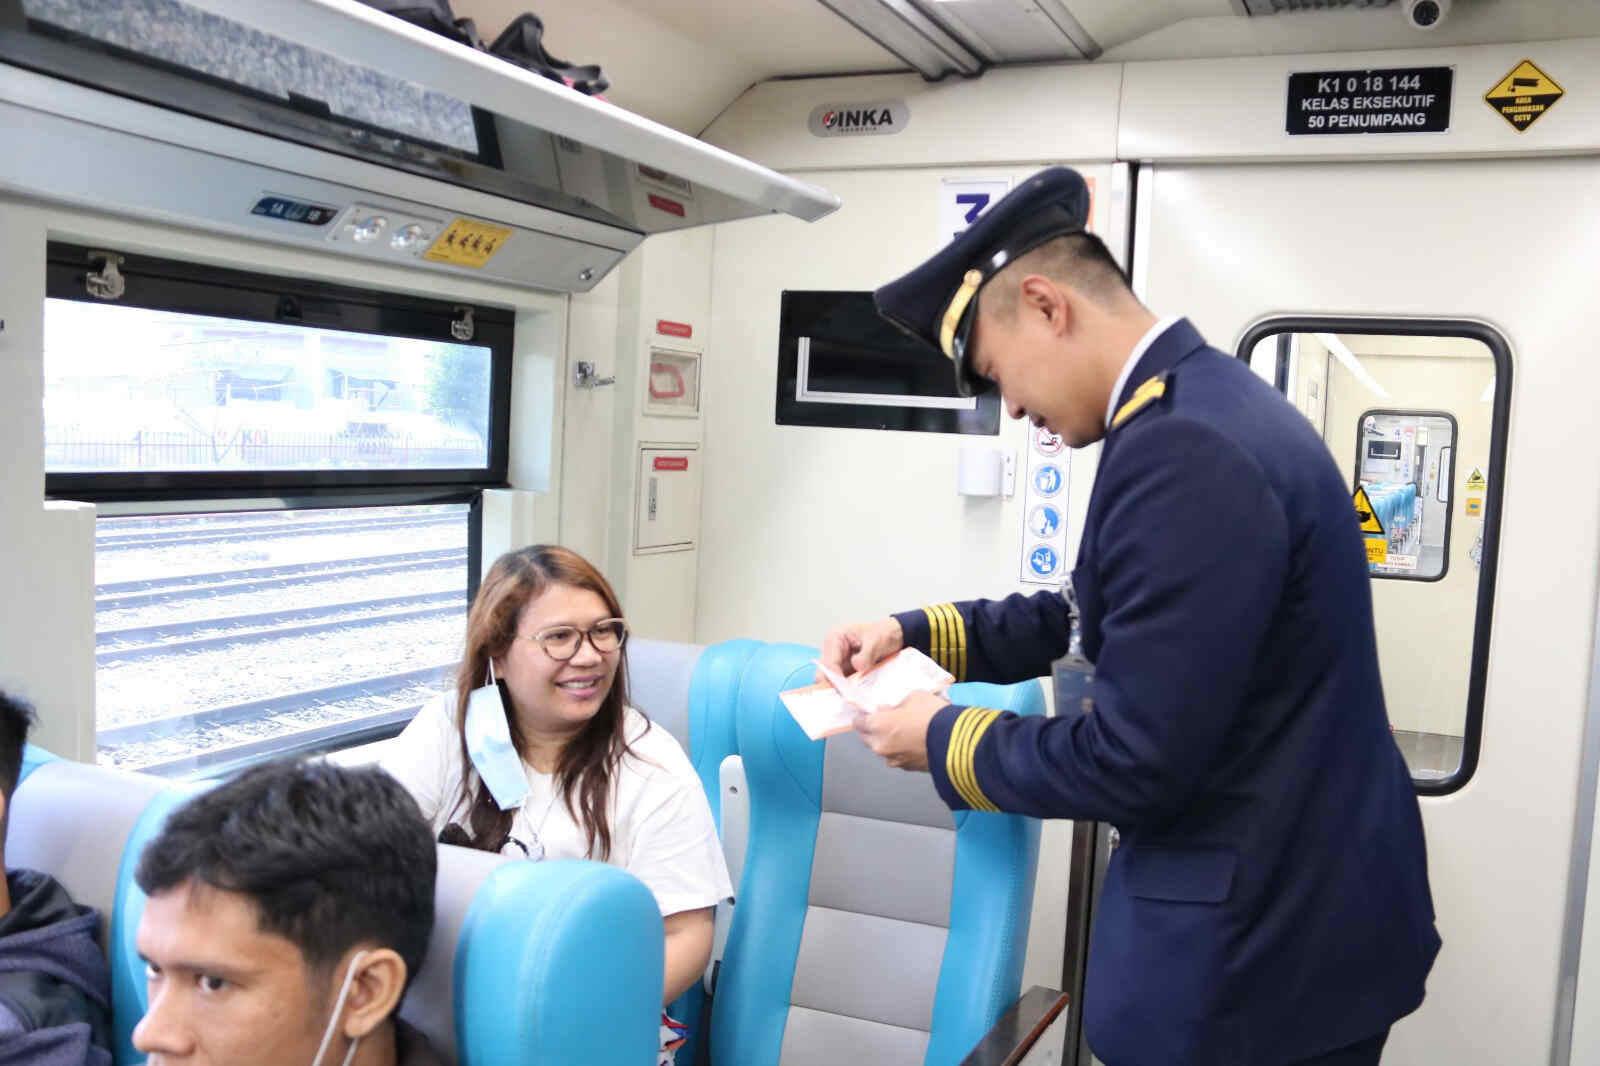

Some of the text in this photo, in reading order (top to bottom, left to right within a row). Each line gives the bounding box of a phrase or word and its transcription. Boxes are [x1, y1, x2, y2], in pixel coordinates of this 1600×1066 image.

[1317, 77, 1340, 93] K1
[1363, 76, 1383, 92] 18
[1389, 74, 1421, 91] 144
[1301, 94, 1436, 111] KELAS EKSEKUTIF
[838, 109, 893, 127] INKA
[1307, 112, 1426, 128] 50 PENUMPANG
[1513, 113, 1531, 122] CCTV
